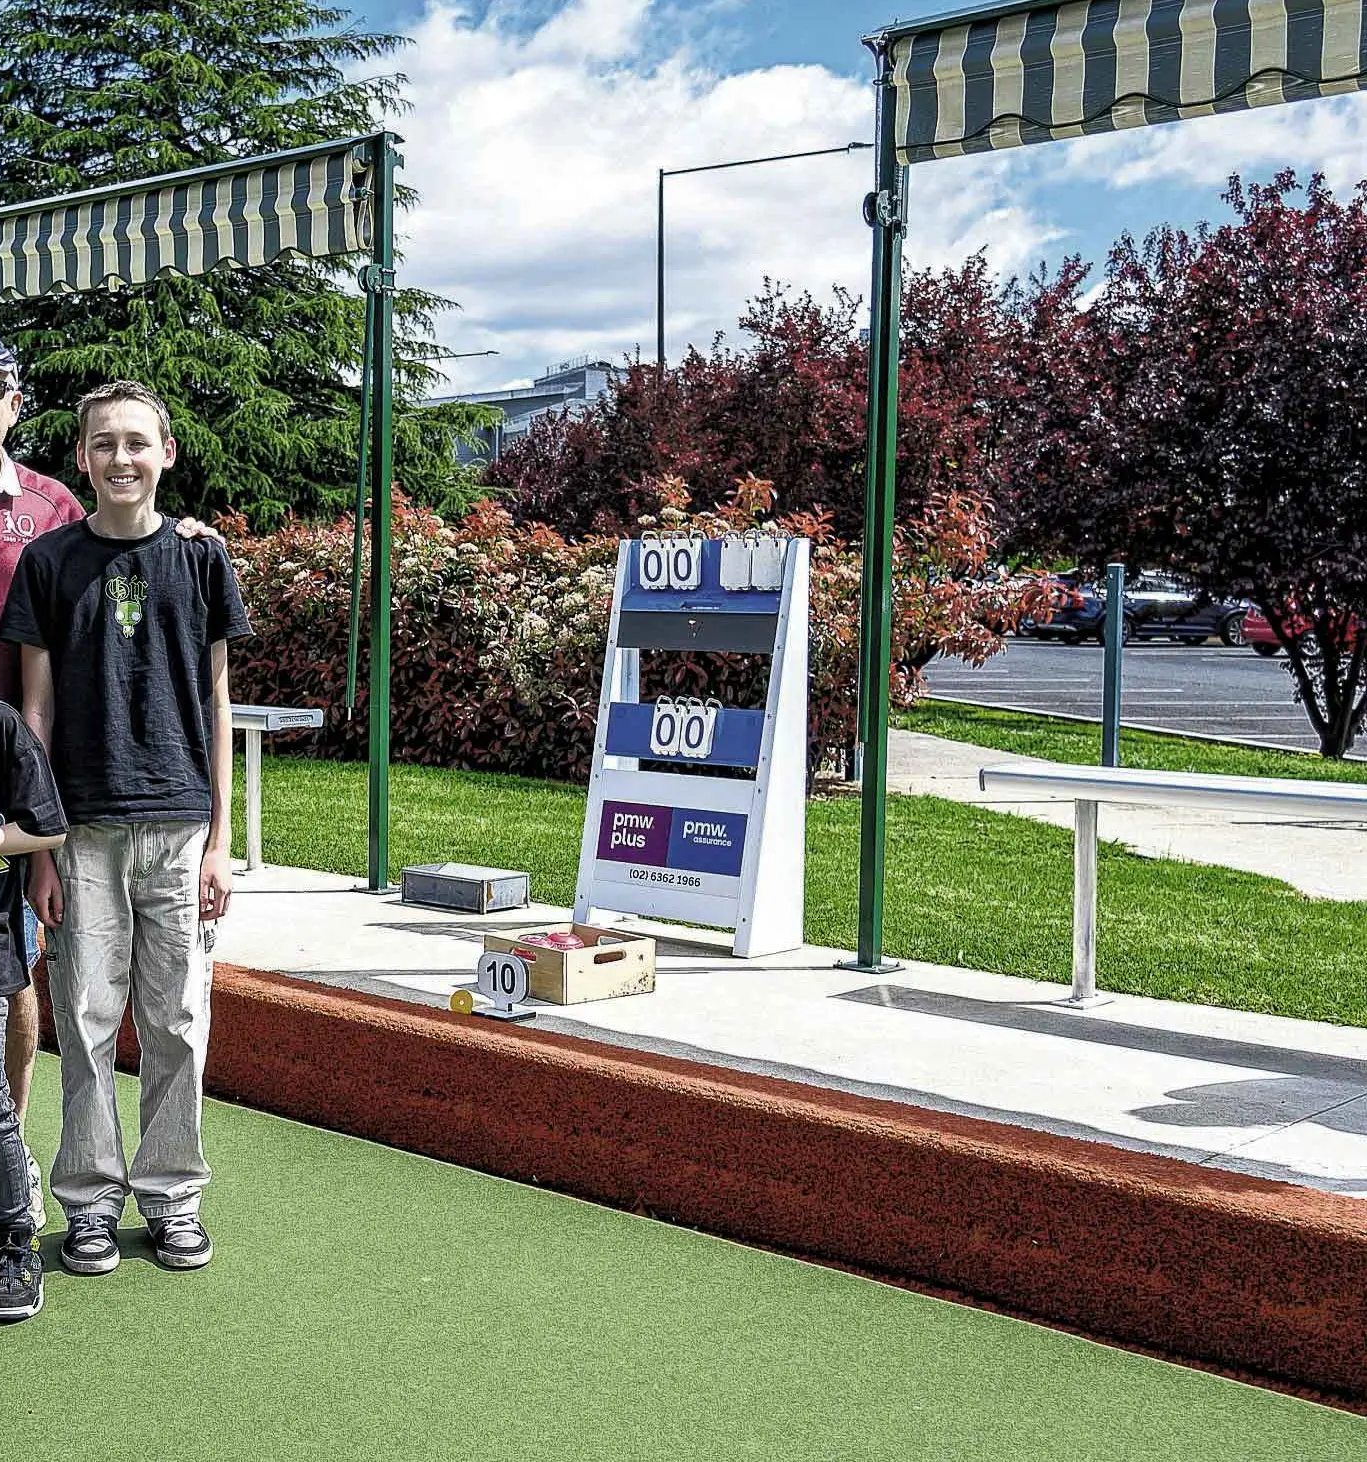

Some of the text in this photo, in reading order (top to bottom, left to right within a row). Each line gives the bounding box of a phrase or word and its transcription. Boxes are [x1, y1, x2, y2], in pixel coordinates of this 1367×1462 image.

[105, 575, 148, 601] Gir
[656, 713, 704, 749] 00
[610, 828, 646, 849] plus
[683, 821, 728, 838] pmw.
[694, 836, 732, 847] assurance
[629, 869, 701, 888] (02) 6362 1966
[486, 960, 516, 995] 10
